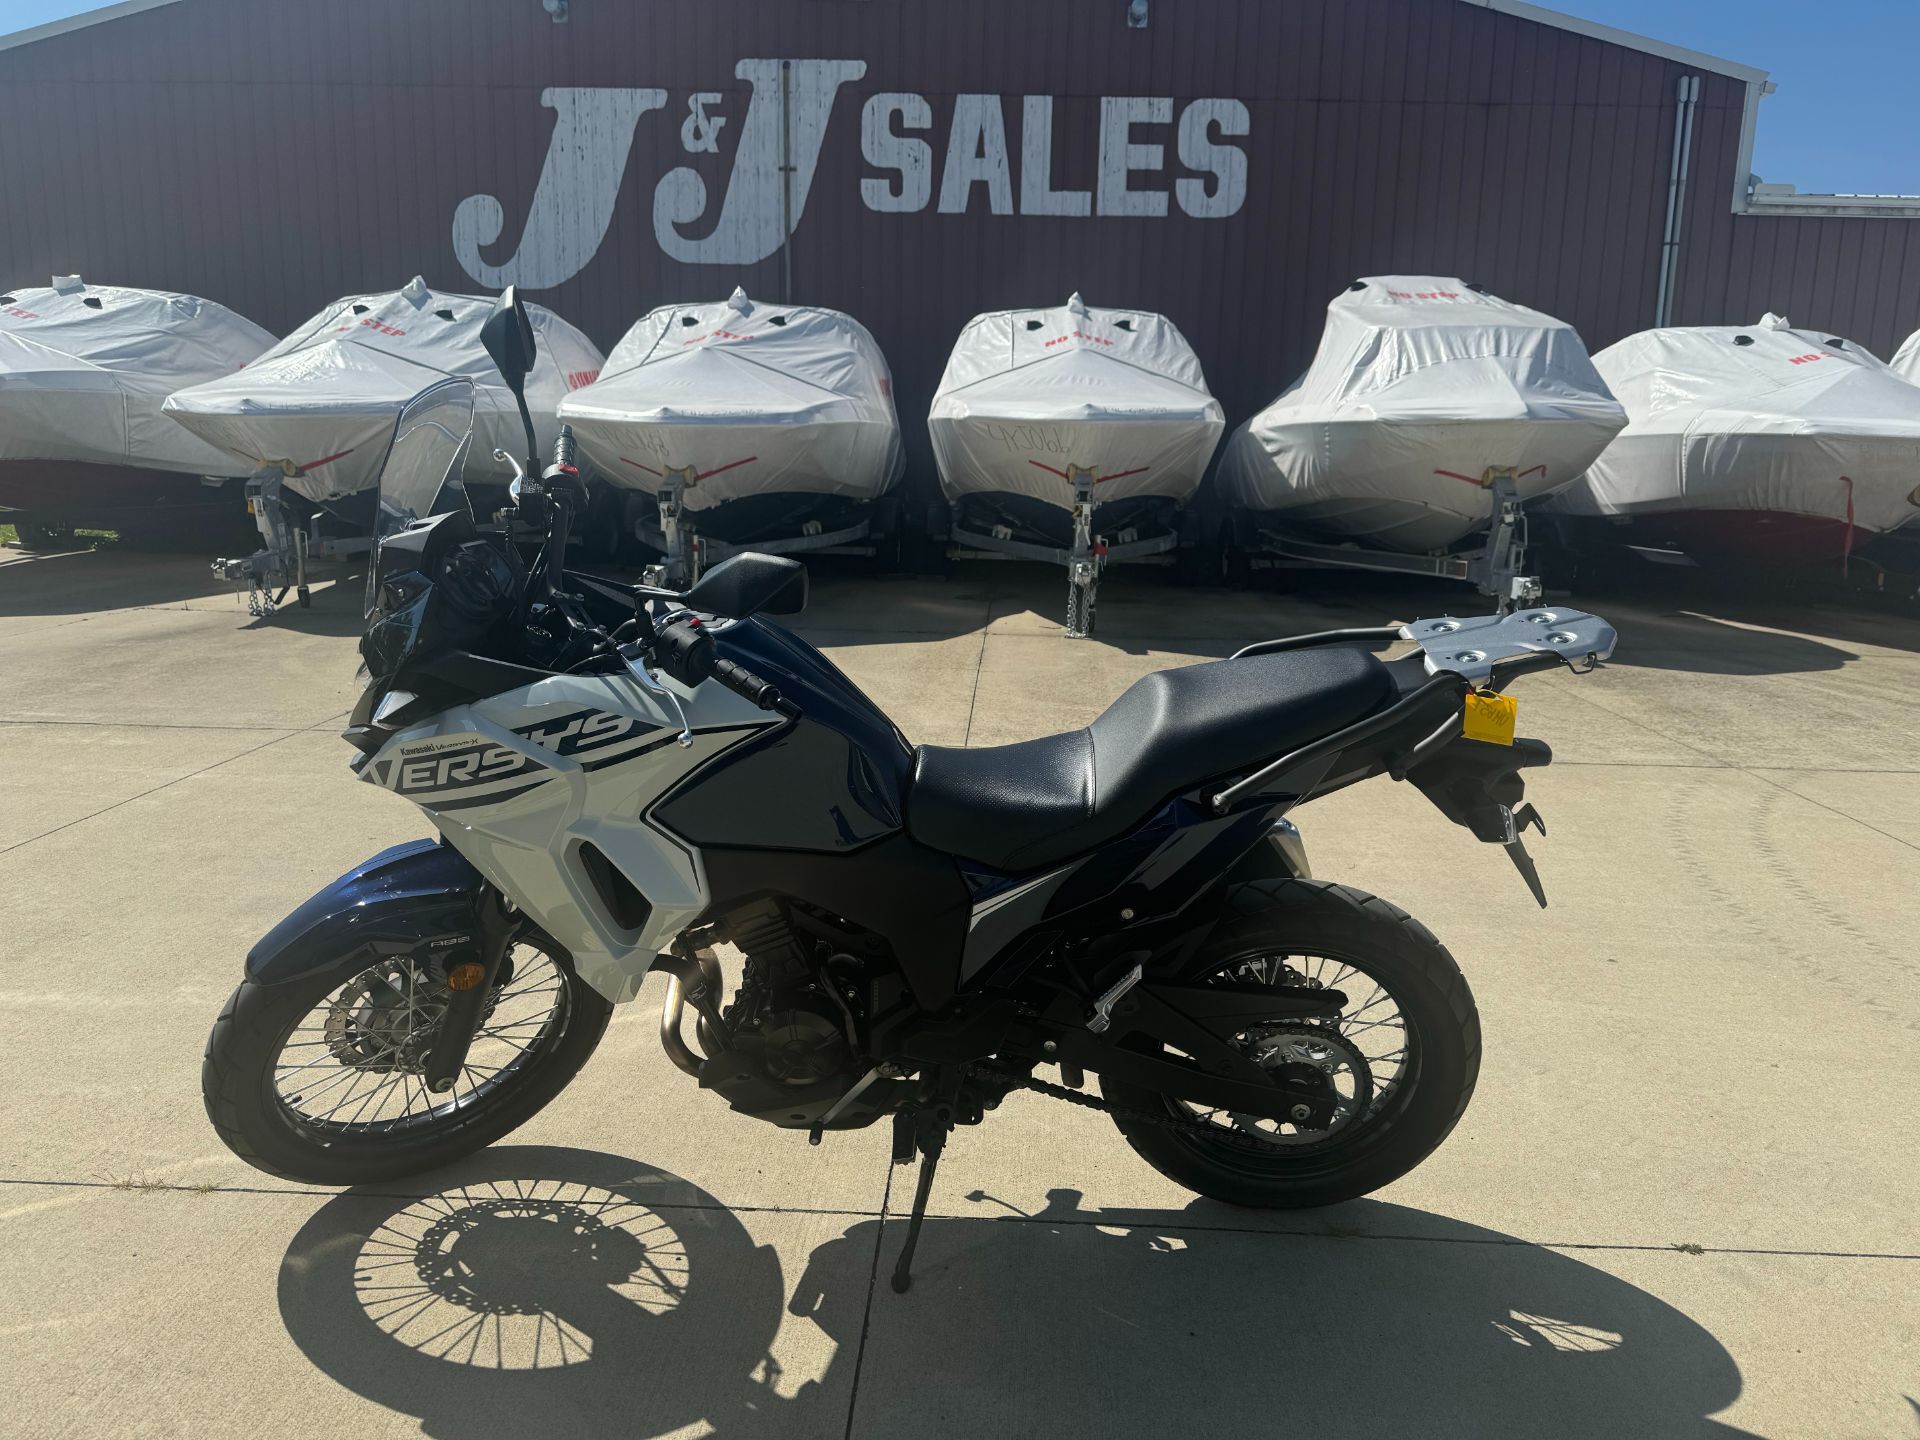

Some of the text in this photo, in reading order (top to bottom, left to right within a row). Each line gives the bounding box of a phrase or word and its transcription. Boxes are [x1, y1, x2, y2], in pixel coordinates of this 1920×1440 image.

[861, 93, 1250, 218] SALES
[360, 318, 407, 336] STEP
[1044, 335, 1068, 347] NO
[1789, 353, 1821, 365] NO
[400, 743, 436, 757] Kawasaki
[430, 935, 471, 948] ABS
